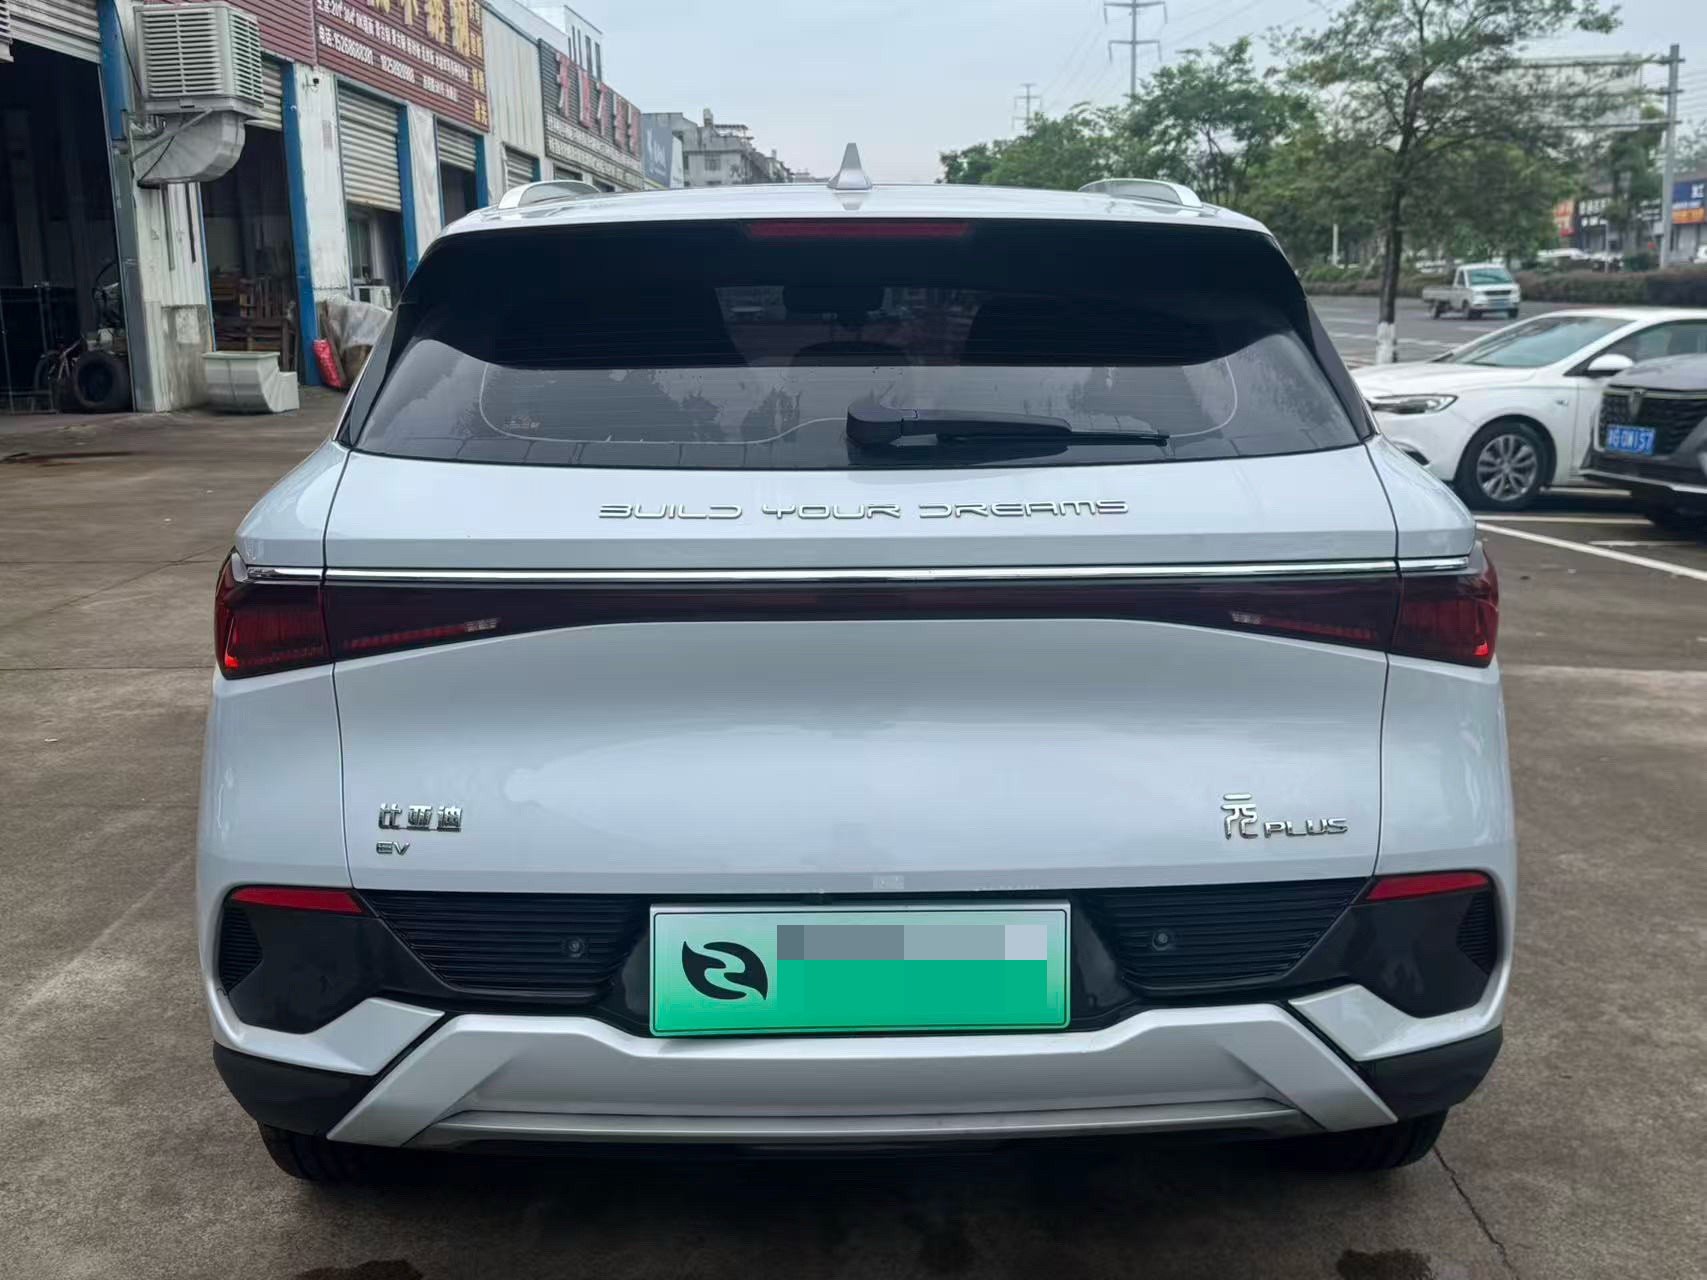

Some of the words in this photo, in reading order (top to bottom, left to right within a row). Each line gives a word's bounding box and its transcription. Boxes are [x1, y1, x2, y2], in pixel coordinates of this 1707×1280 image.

[598, 503, 743, 520] BUILD
[760, 503, 901, 520] YOUR
[919, 499, 1129, 520] DREAMS
[378, 803, 463, 832] 比亚迪
[1220, 792, 1259, 840] 元
[1263, 818, 1349, 839] PLUS
[376, 841, 411, 857] EV
